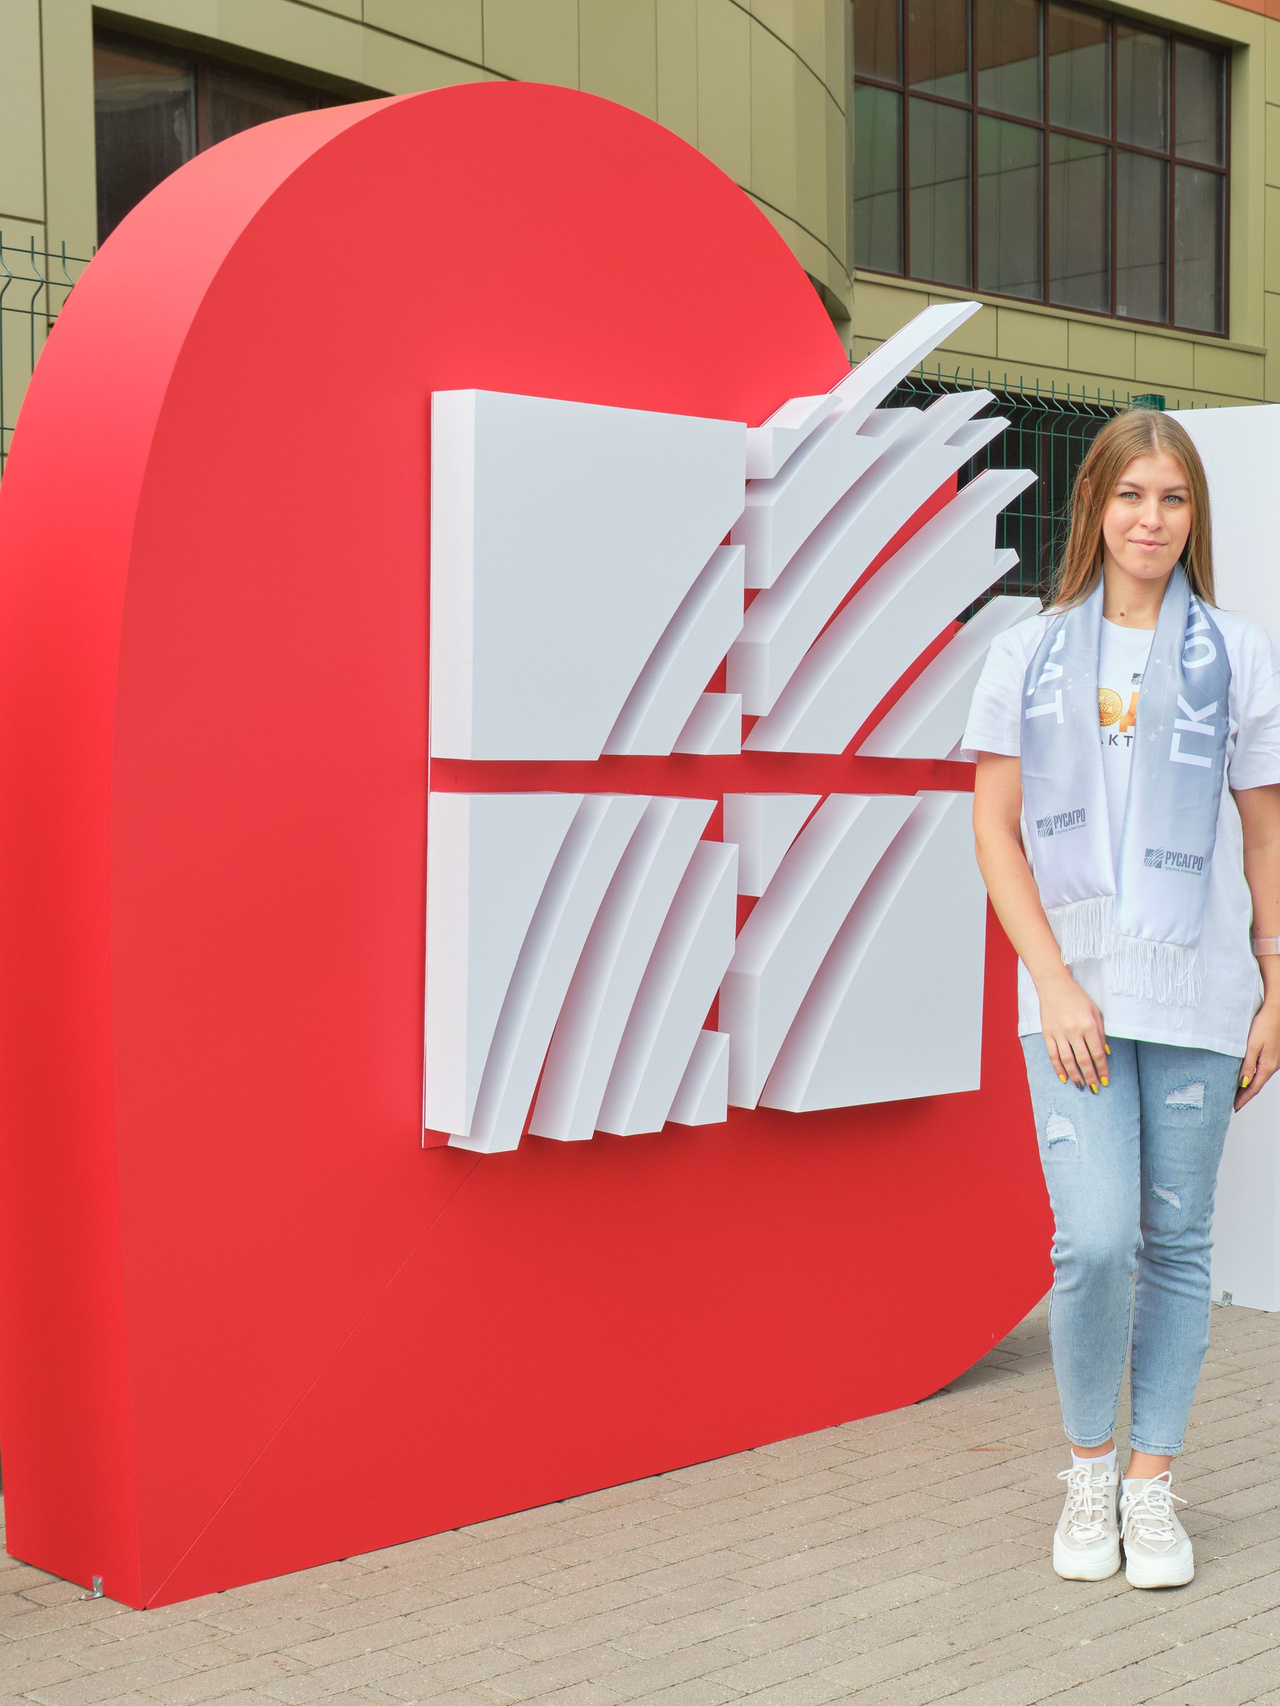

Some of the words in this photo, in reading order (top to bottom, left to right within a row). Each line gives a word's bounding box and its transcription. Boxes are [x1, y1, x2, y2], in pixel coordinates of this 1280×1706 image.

[1169, 693, 1218, 768] ГК
[1053, 808, 1086, 829] РУСАГРО
[1164, 850, 1204, 871] РУСАГРО
